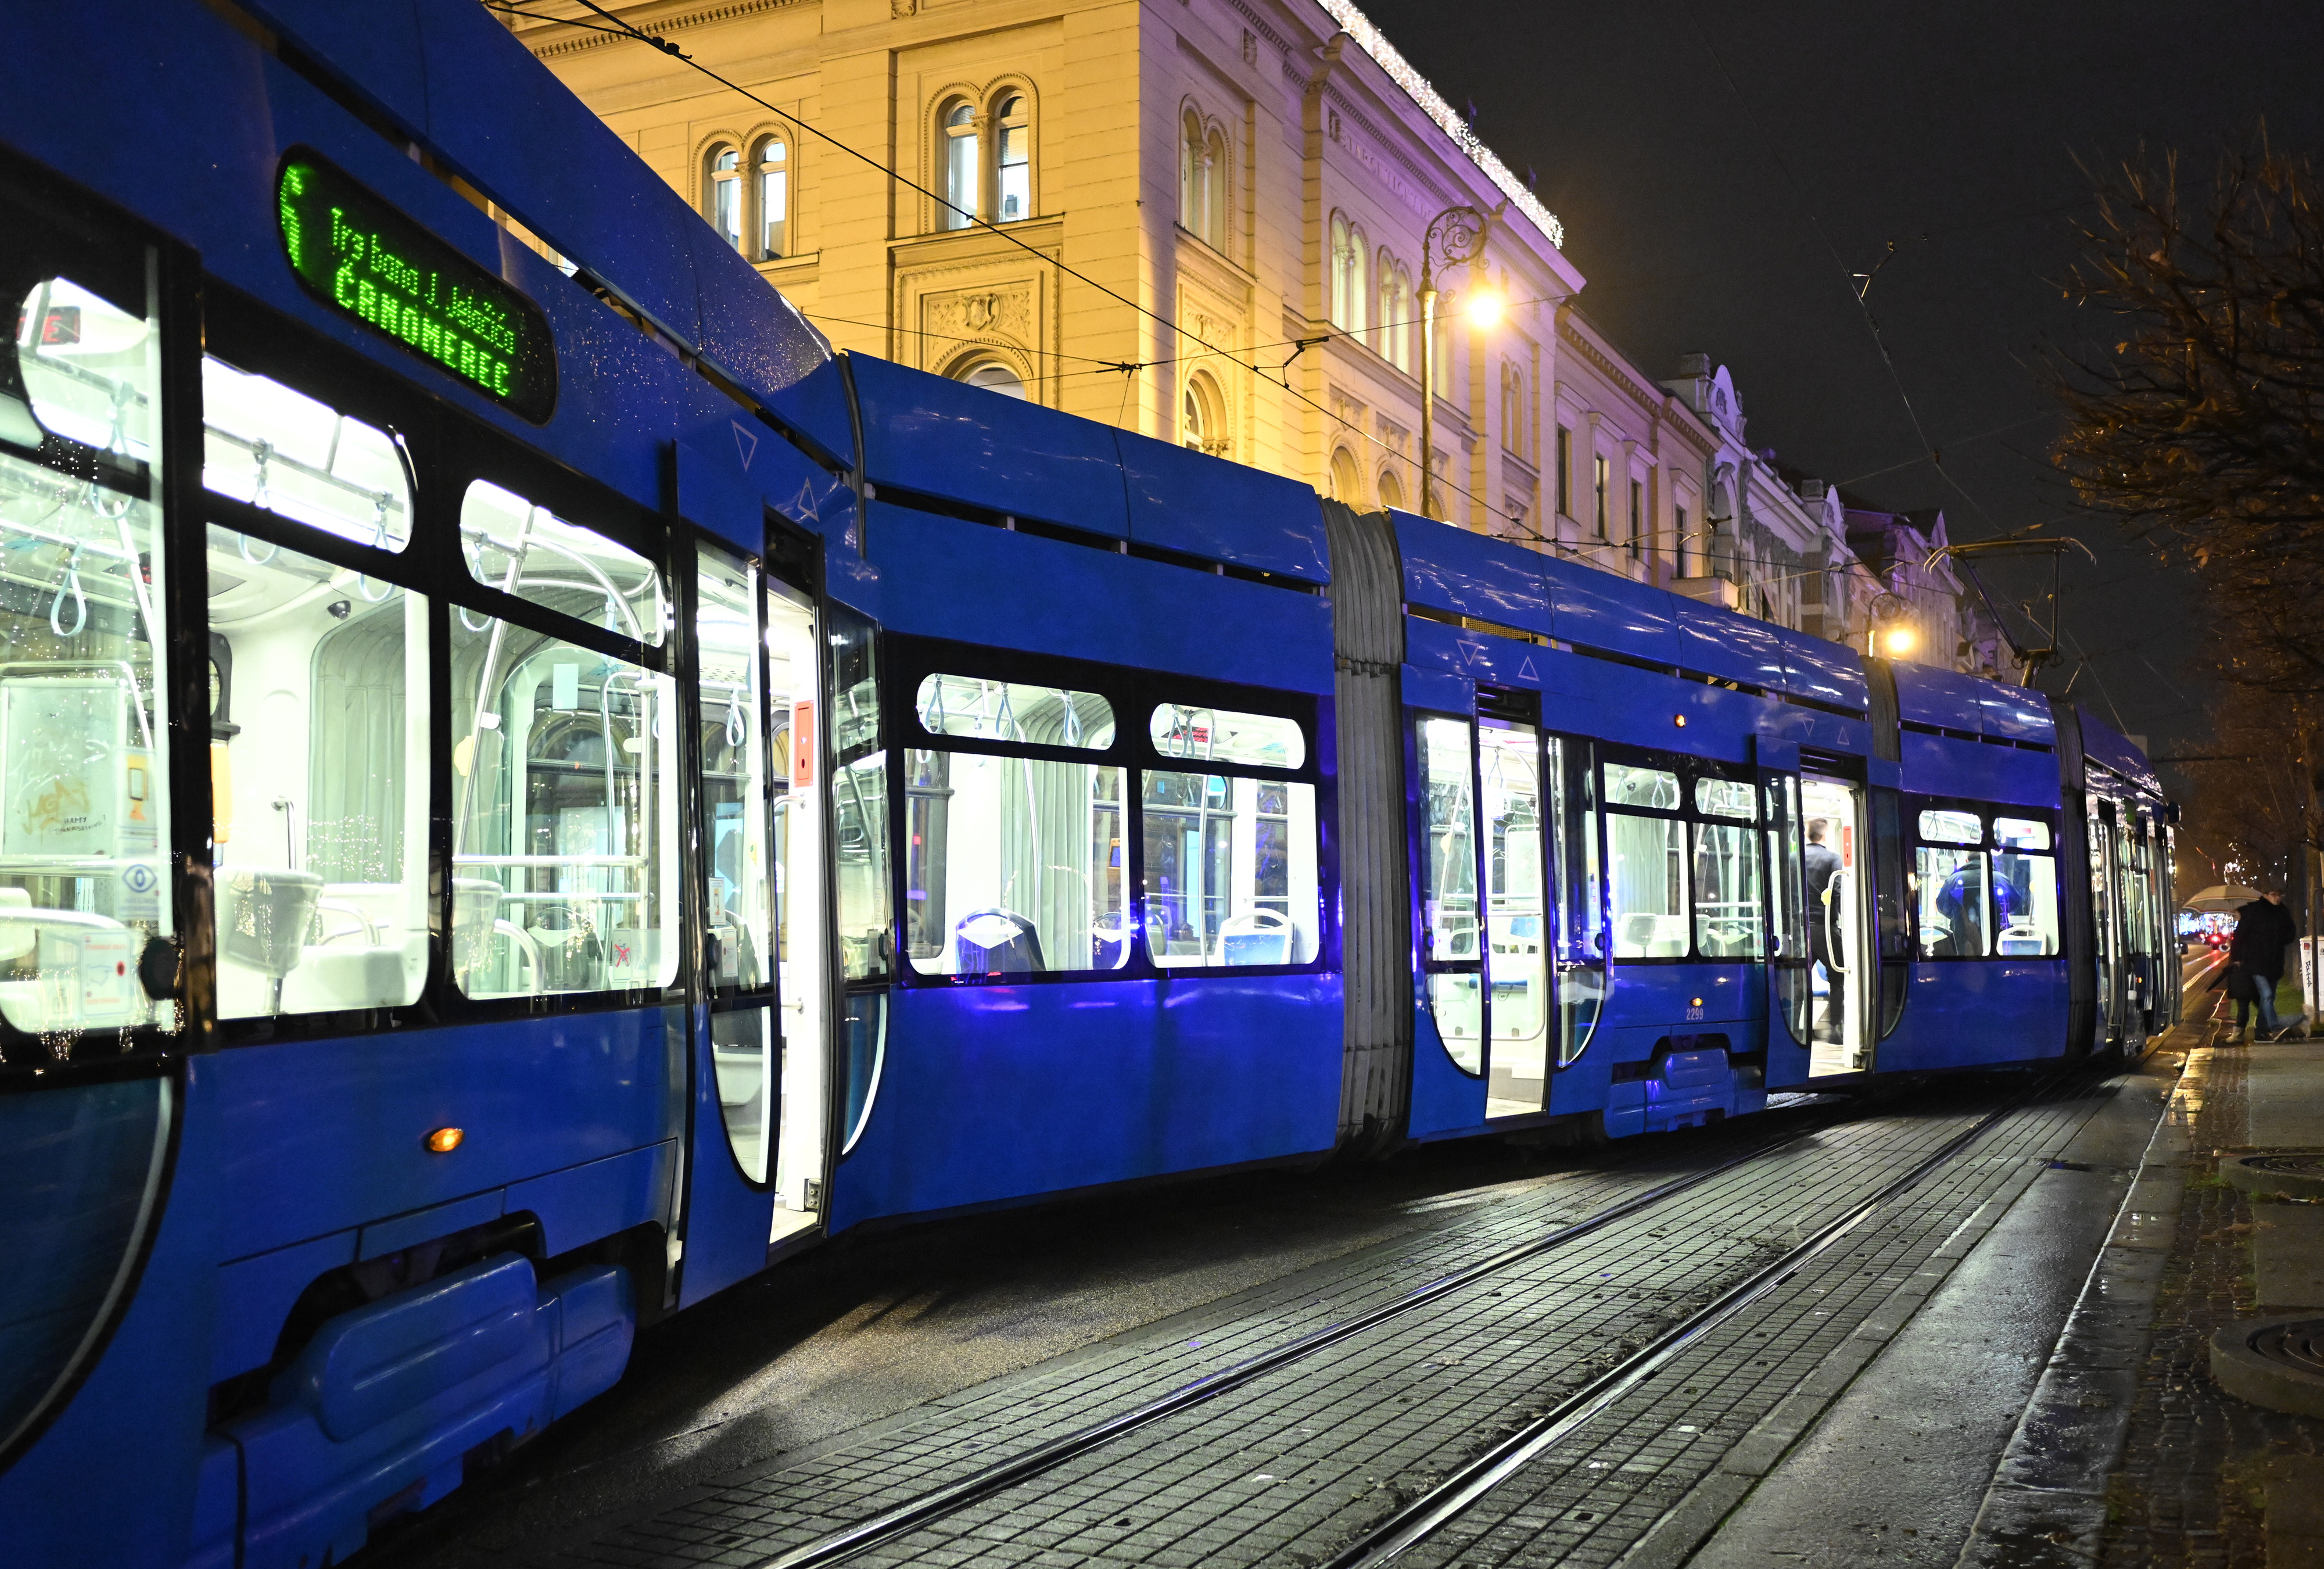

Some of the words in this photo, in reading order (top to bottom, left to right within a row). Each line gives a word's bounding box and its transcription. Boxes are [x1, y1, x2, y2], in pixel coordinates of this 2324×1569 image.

[331, 207, 364, 260] Trg
[370, 234, 419, 296] bana
[335, 258, 510, 397] ČRNOMEREC
[63, 816, 87, 825] HAPPY
[1686, 1007, 1704, 1020] 2299
